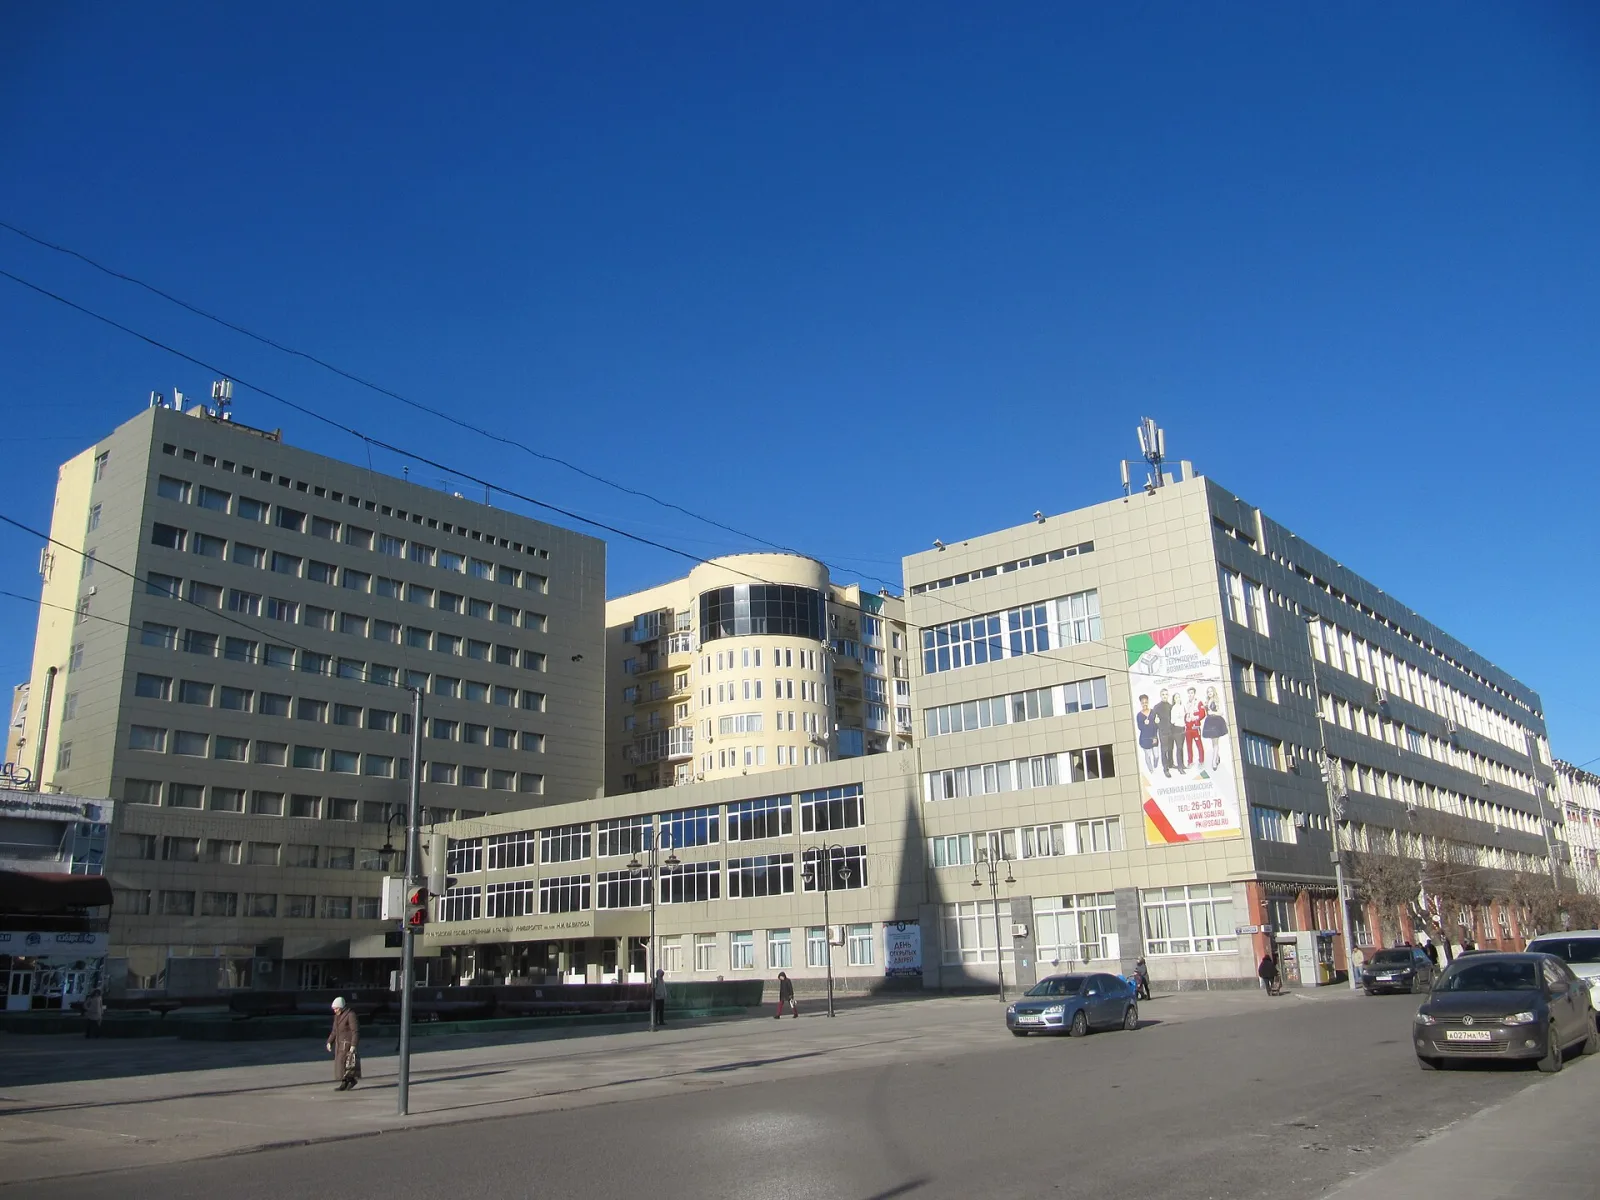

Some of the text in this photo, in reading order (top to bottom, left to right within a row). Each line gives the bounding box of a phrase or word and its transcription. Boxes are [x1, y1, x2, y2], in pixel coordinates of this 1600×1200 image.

[1191, 798, 1223, 811] 26-50-78
[1188, 809, 1225, 821] WWW.SGAU.RU
[894, 941, 912, 950] ДЕНЬ
[890, 949, 917, 957] ОТКРЫТЫХ
[893, 956, 914, 965] ДВЕРЕЙ
